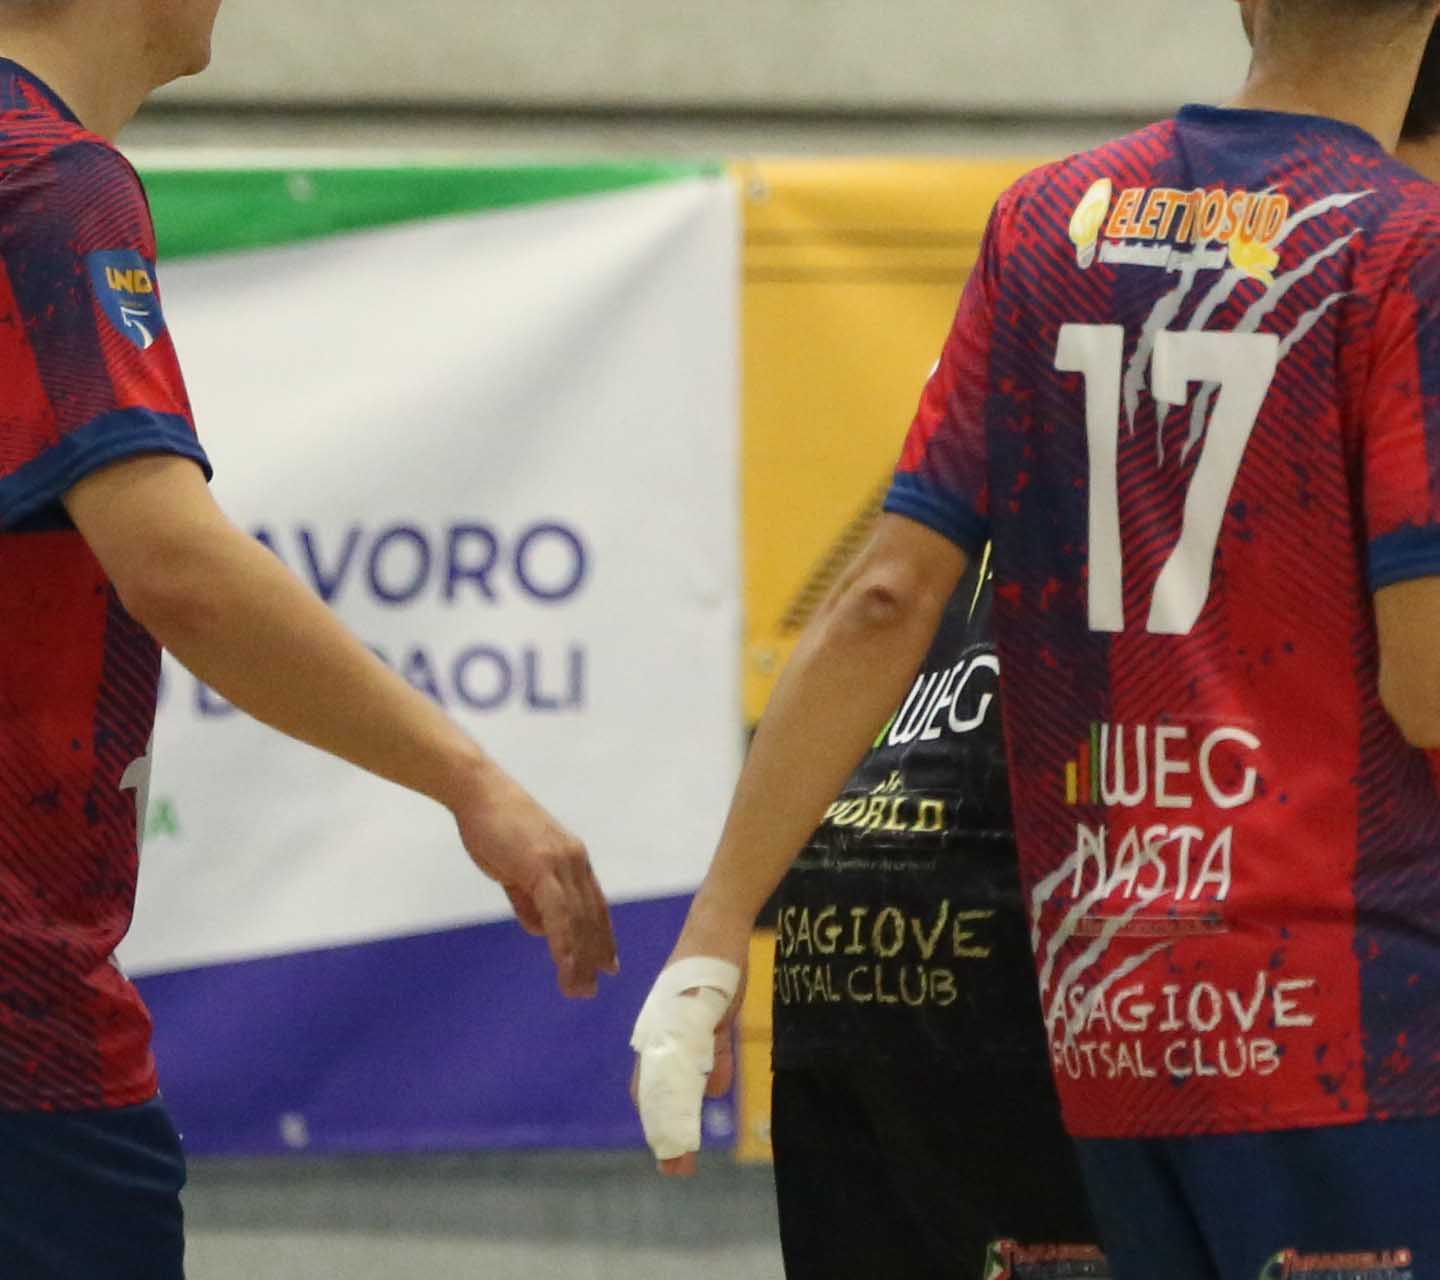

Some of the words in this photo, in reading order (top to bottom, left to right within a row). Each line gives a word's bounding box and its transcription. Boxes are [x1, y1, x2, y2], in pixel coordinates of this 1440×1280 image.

[1055, 324, 1281, 634] 17
[1100, 722, 1261, 809] WEG
[1071, 822, 1233, 901] NASTA
[847, 964, 957, 1006] CLUB
[1164, 1035, 1281, 1078] CLUB
